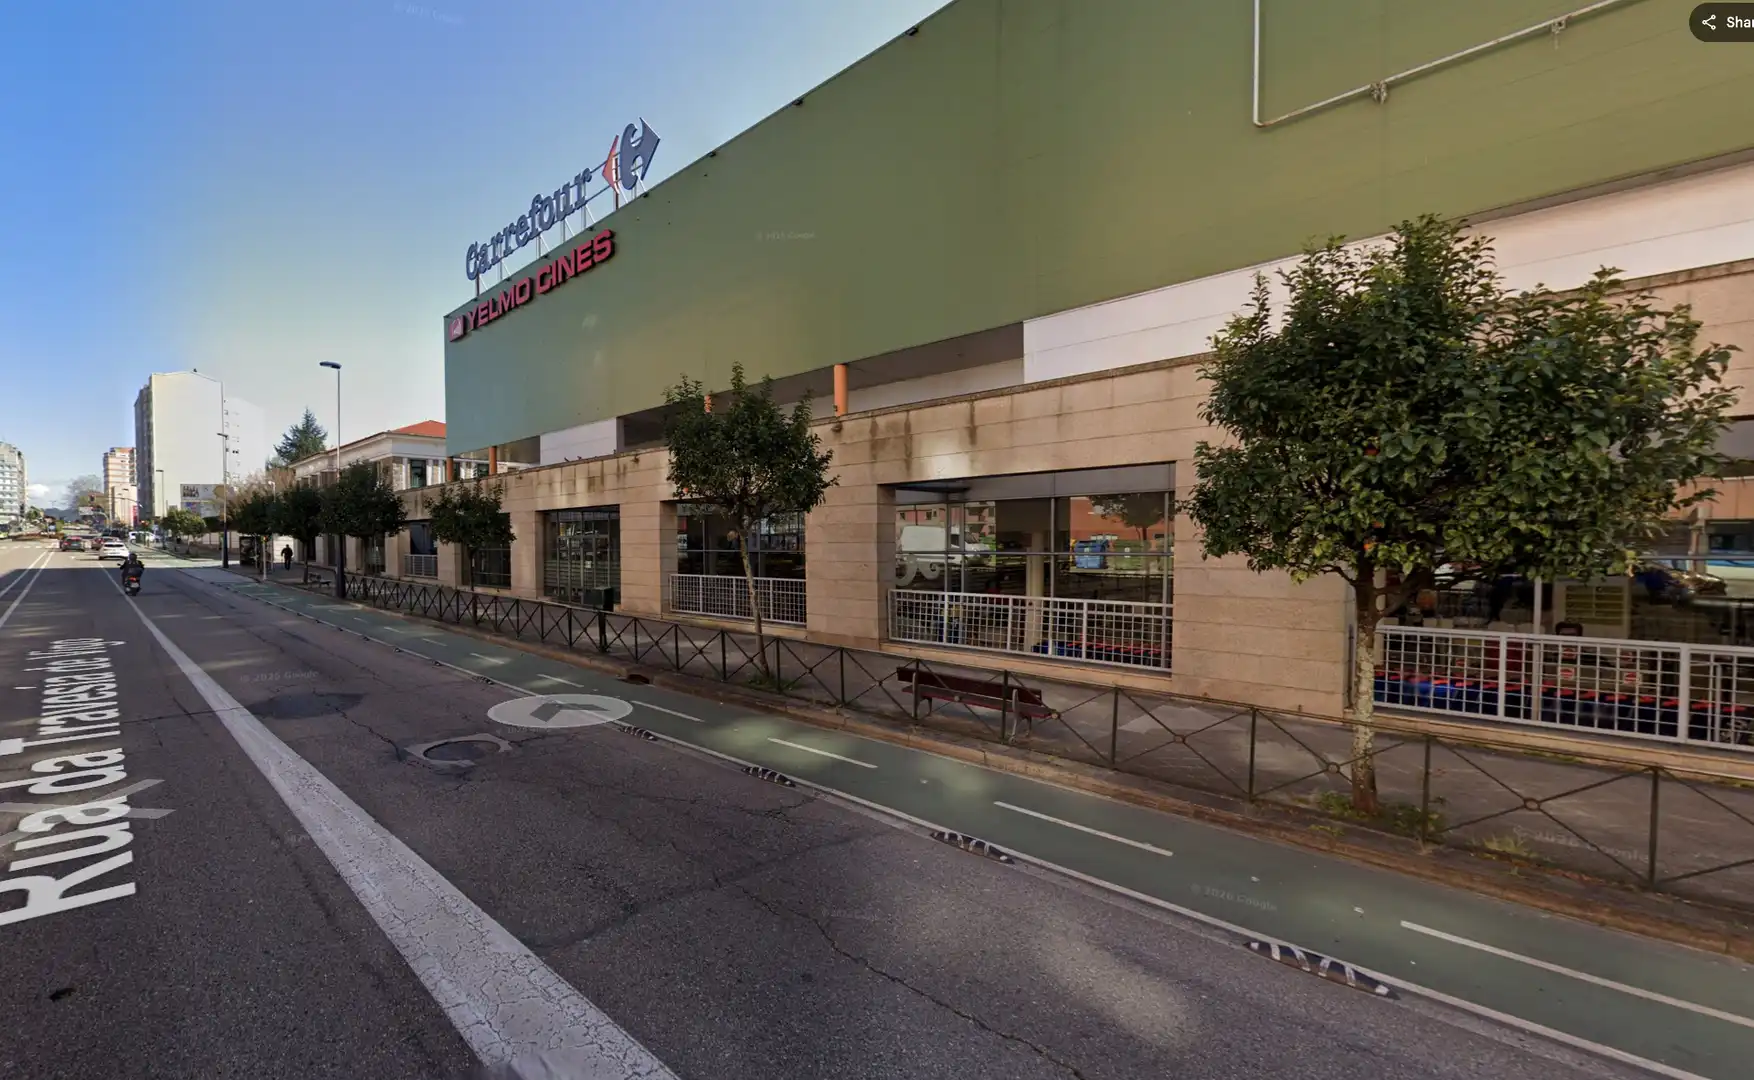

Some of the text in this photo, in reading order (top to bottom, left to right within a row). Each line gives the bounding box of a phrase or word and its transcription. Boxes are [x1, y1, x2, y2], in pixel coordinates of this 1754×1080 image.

[466, 168, 592, 281] Carrefour
[466, 229, 613, 330] YELMO CINES
